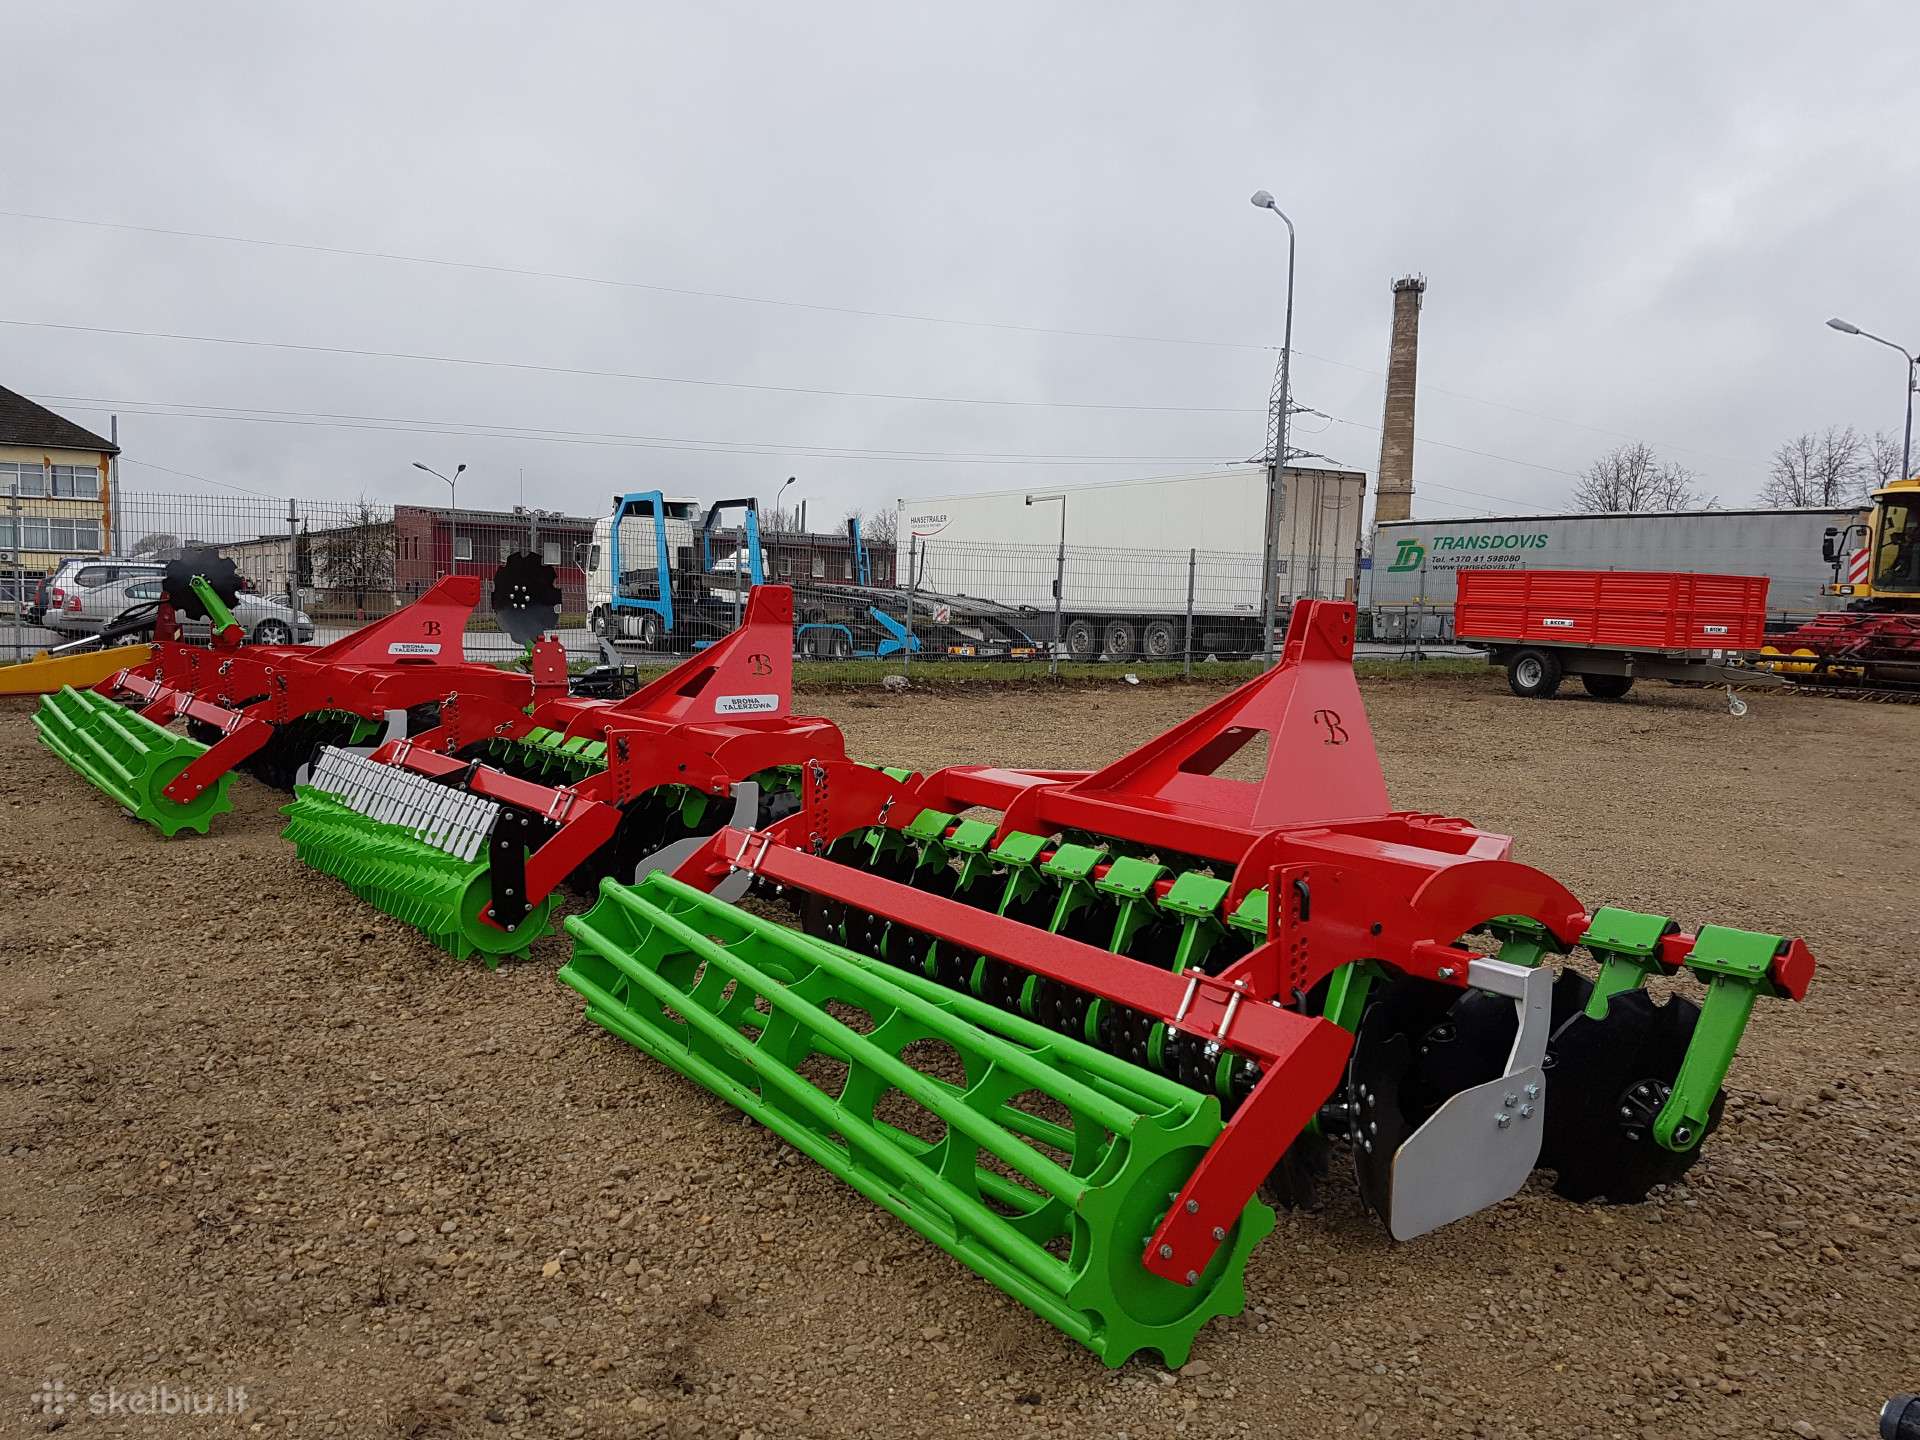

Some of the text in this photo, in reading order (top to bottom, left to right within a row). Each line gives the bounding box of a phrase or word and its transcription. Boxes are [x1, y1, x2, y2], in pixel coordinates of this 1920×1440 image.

[1433, 534, 1549, 550] TRANSDOVIS
[1474, 555, 1485, 563] 41
[1487, 554, 1521, 563] 598080
[1432, 563, 1516, 571] www.transdovis.lt
[747, 653, 773, 676] B
[722, 702, 772, 711] TALERZOWA
[1314, 709, 1349, 745] B
